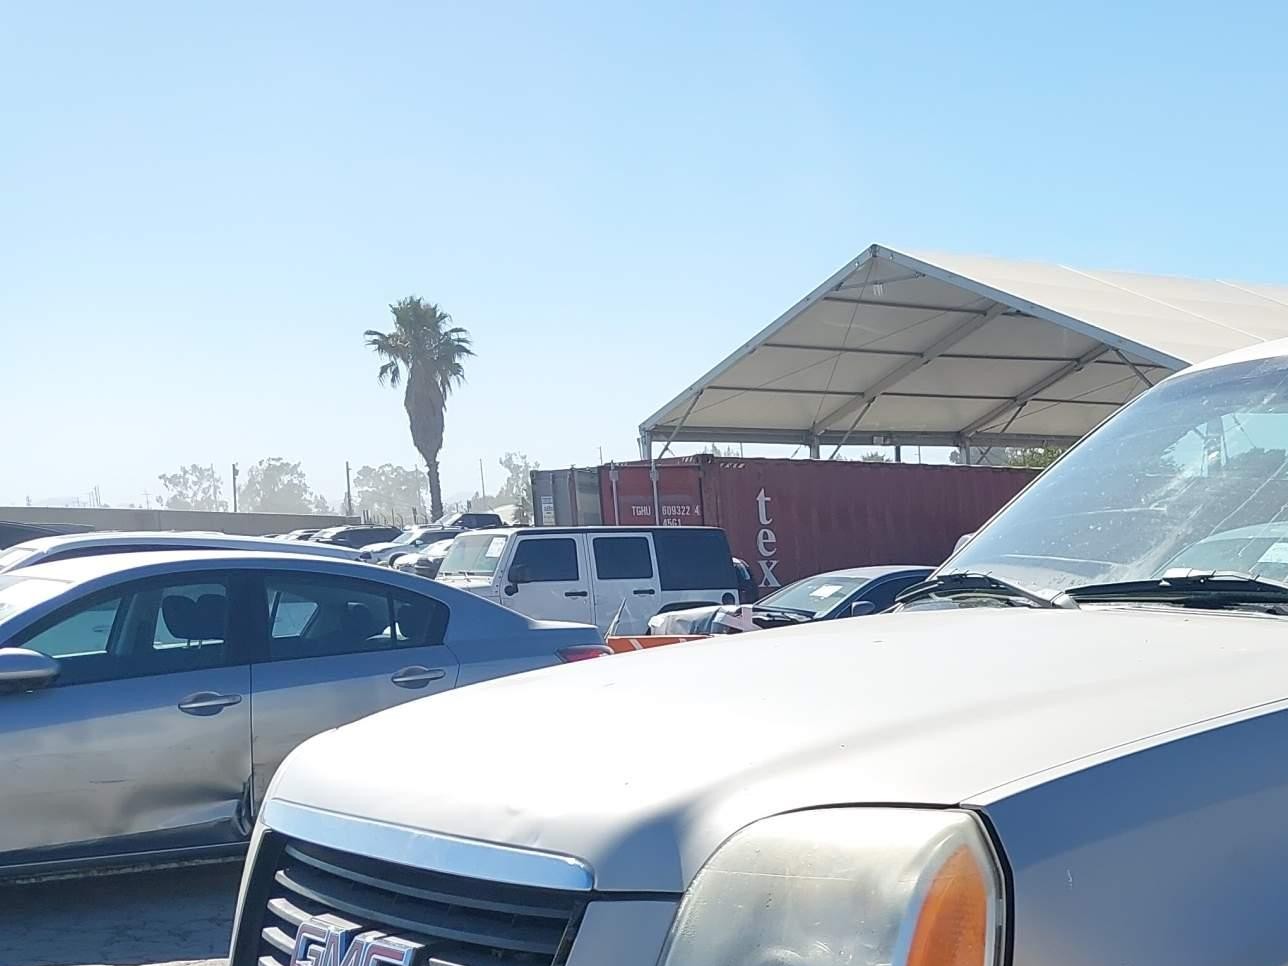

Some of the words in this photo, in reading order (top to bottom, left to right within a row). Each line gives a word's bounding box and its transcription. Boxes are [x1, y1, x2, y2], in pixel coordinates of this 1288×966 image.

[631, 505, 652, 516] TGHU
[661, 504, 691, 516] 609322
[694, 503, 701, 517] 4
[755, 487, 781, 588] tex
